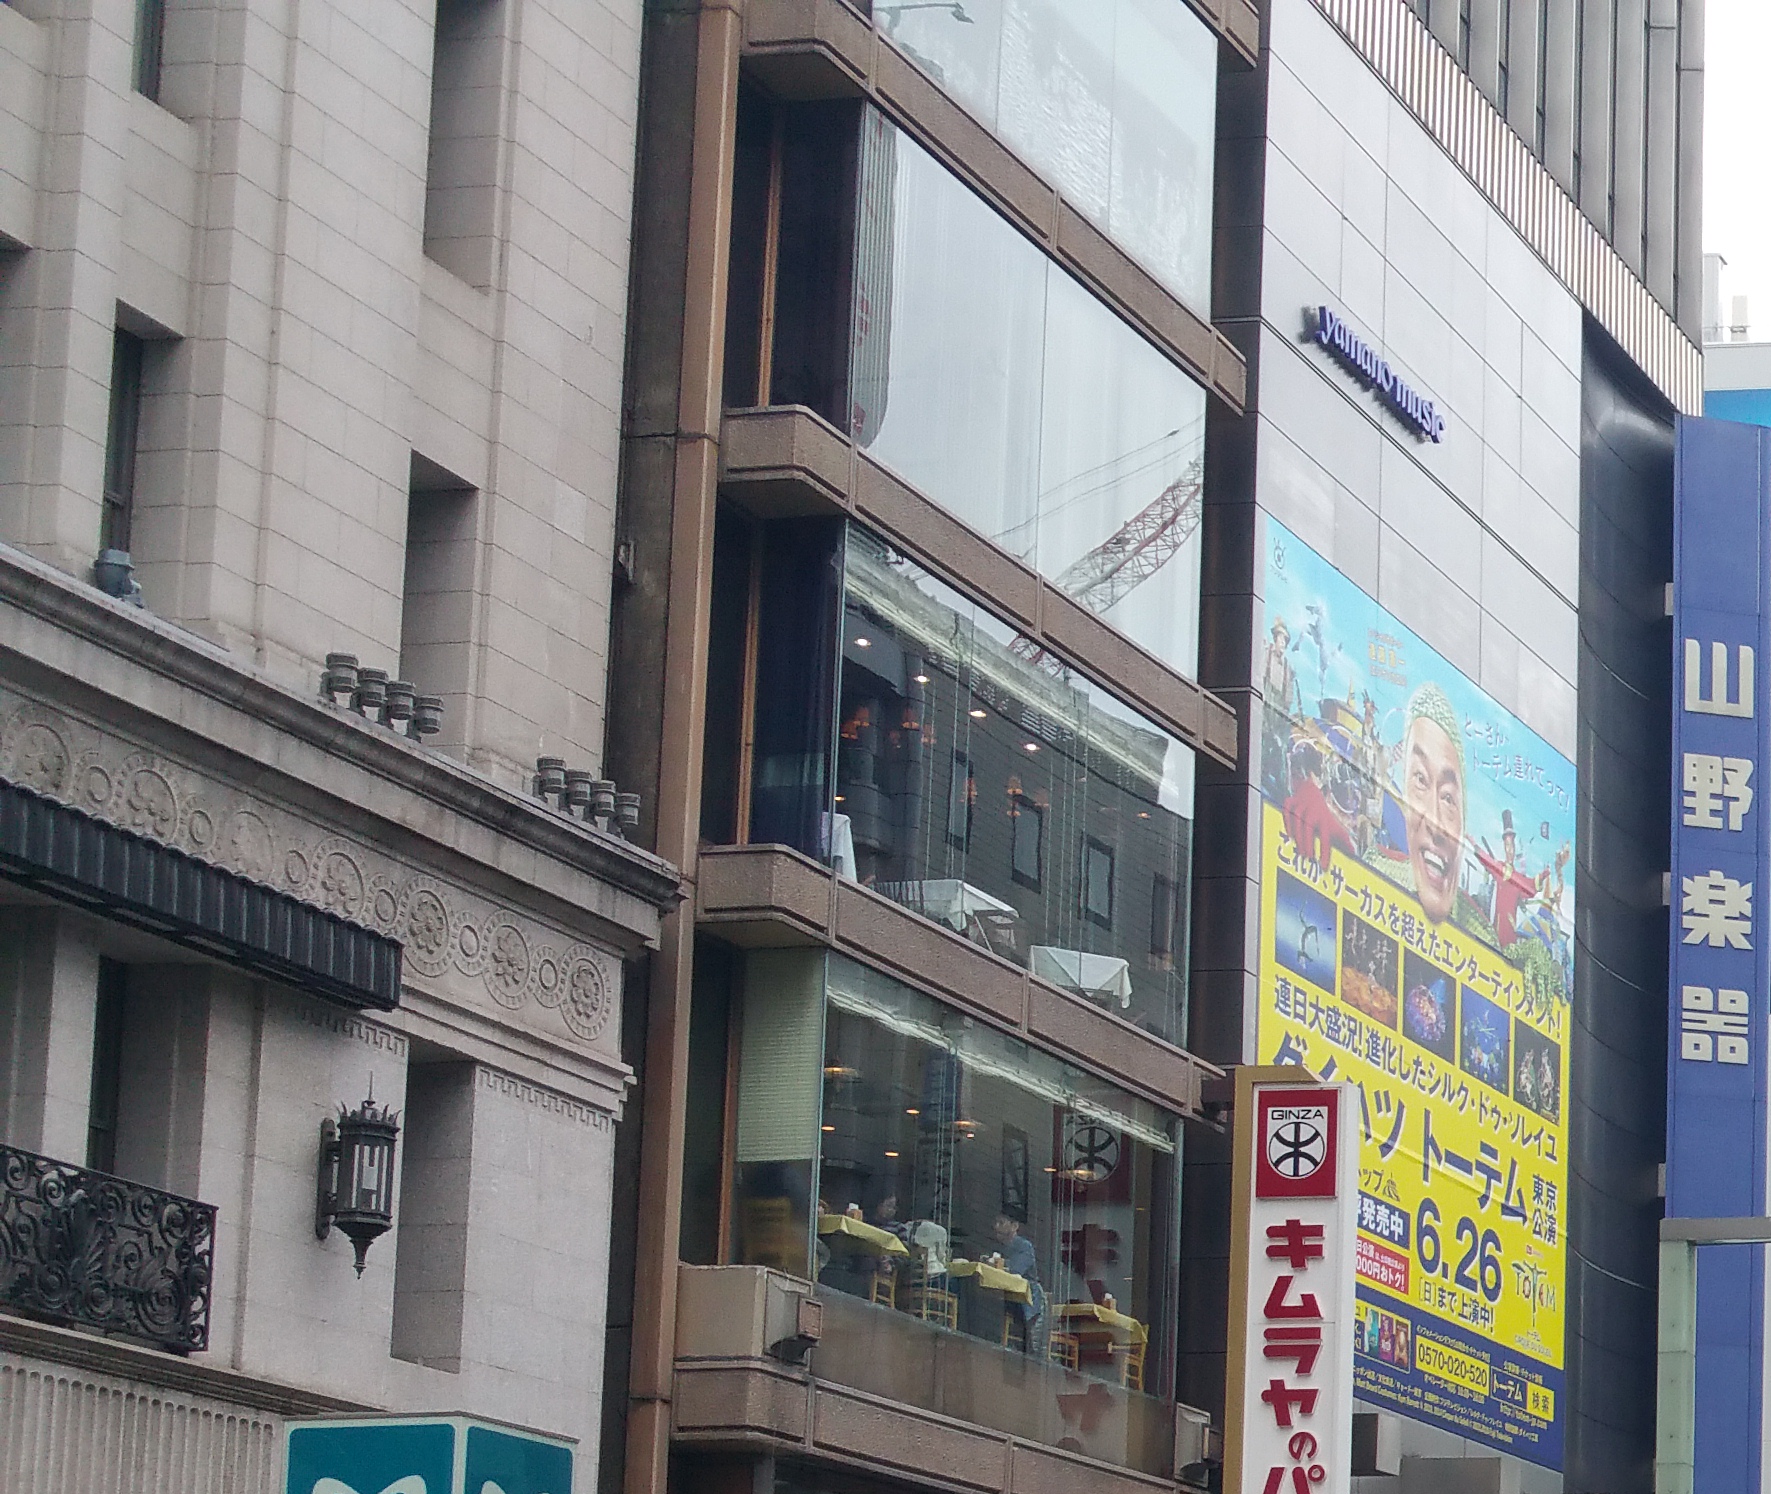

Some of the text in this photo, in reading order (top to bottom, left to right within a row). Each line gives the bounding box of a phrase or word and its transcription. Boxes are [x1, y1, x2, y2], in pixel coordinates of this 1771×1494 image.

[1318, 303, 1447, 443] yamano music
[1681, 636, 1755, 1066] 山野楽器
[1270, 1108, 1325, 1121] GINZA
[1422, 1107, 1528, 1227] トーテム
[1531, 1173, 1559, 1213] 東京
[1416, 1197, 1503, 1304] 6.26
[1531, 1209, 1558, 1246] 公演
[1417, 1342, 1488, 1389] 0570-020-520
